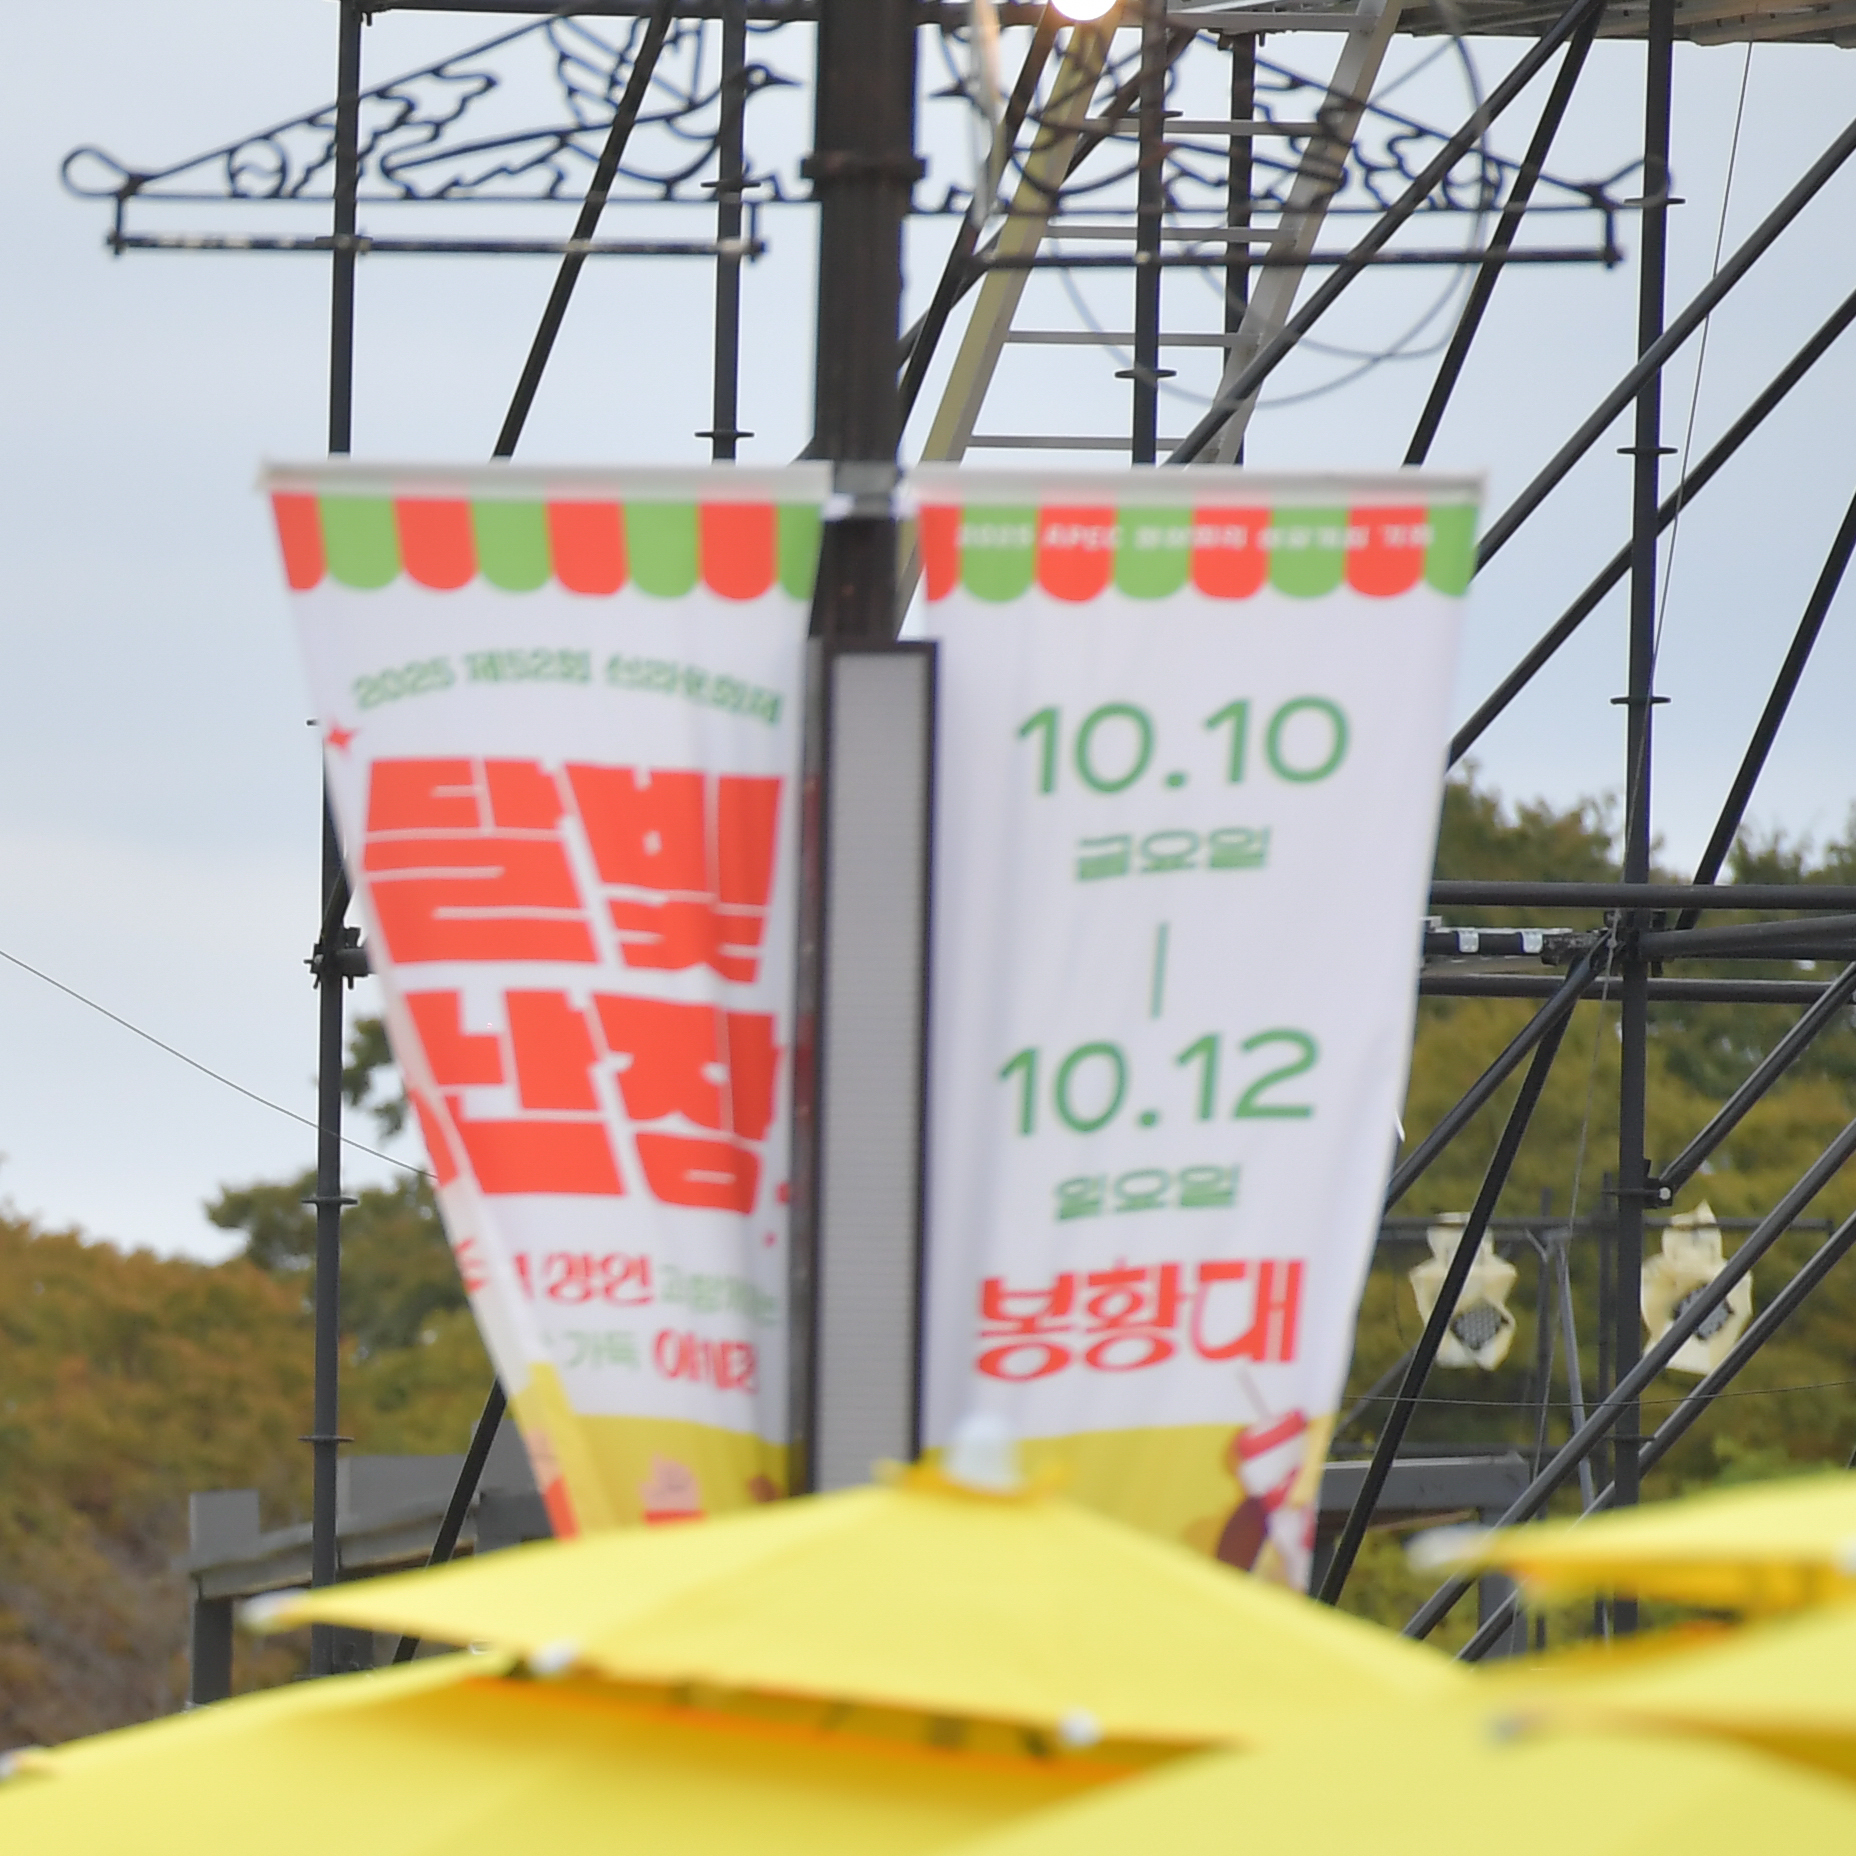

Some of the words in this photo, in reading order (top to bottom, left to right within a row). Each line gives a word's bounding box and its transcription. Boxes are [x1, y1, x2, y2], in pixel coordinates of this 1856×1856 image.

[1016, 694, 1350, 797] 10.10
[362, 756, 786, 984] 달빛
[998, 1027, 1320, 1138] 10.12
[974, 1257, 1308, 1385] 봉황대
